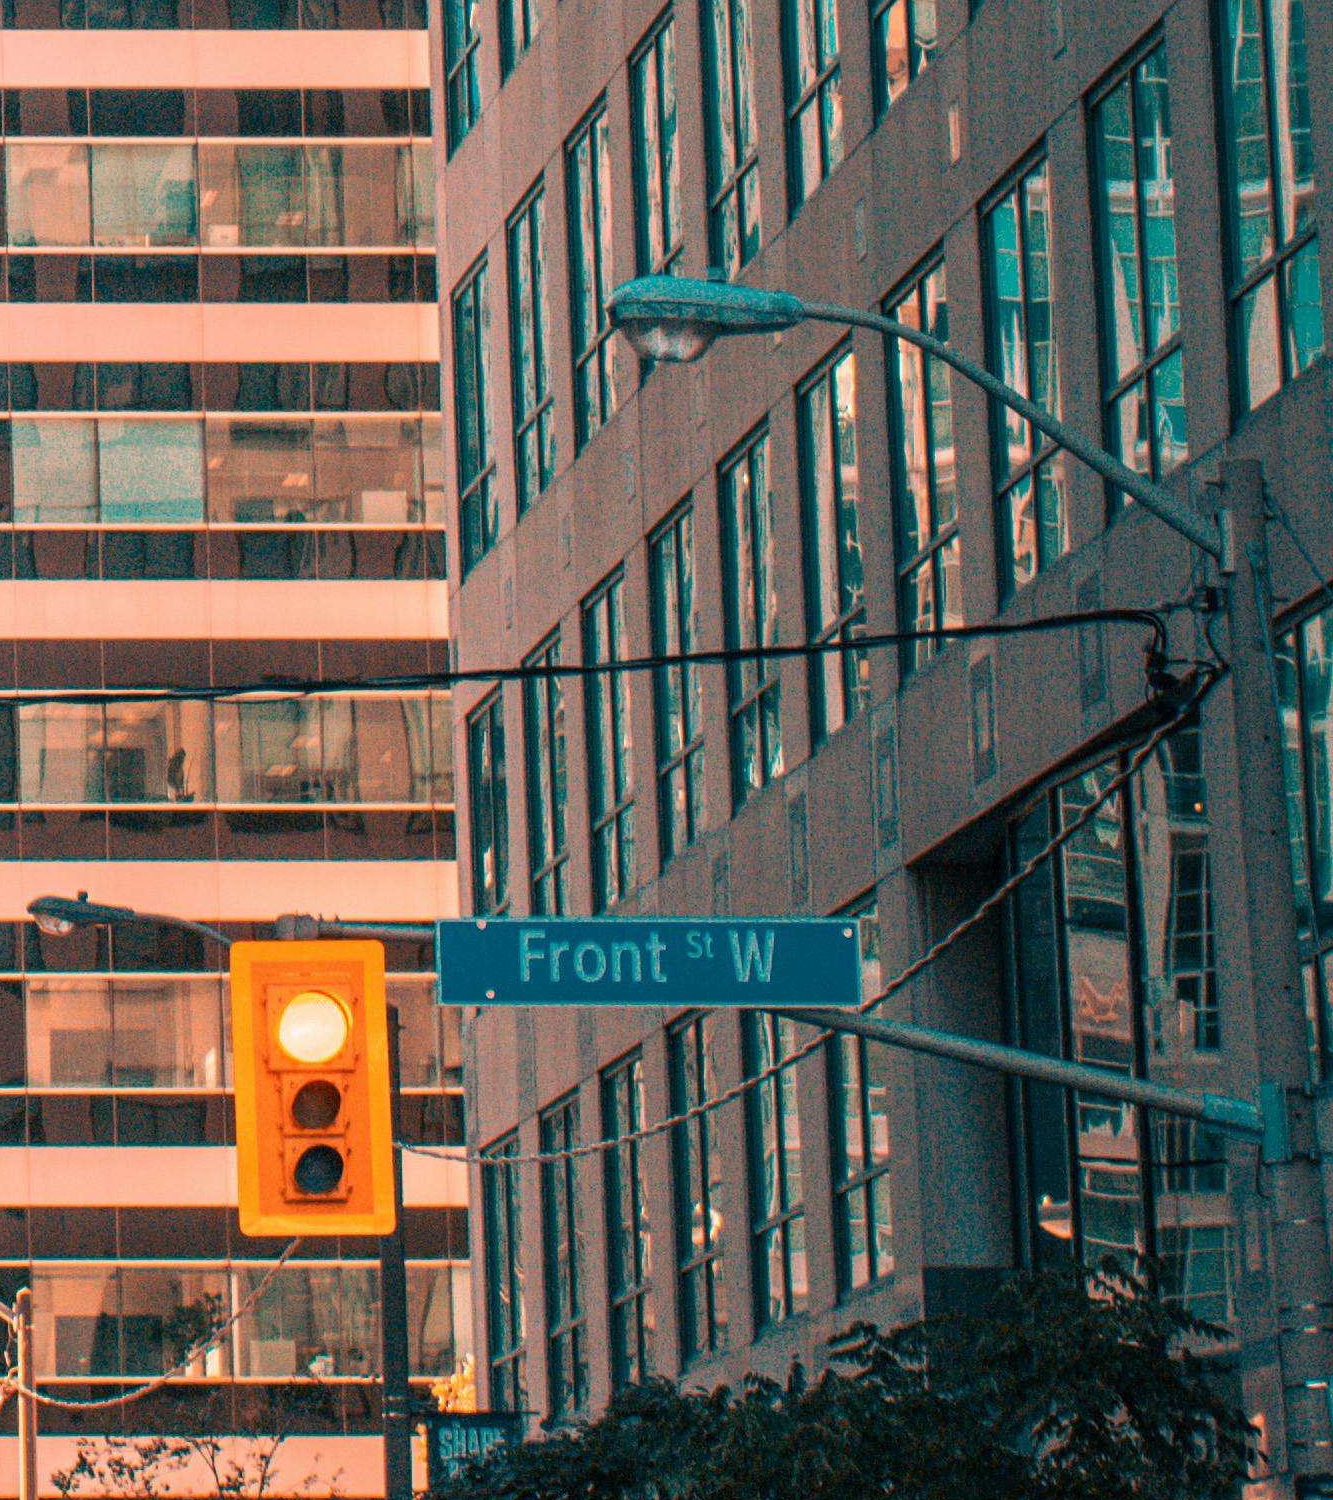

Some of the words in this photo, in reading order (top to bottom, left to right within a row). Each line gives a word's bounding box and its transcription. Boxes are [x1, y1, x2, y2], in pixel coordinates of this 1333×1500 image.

[518, 927, 667, 984] Front
[684, 929, 716, 959] St
[729, 928, 776, 984] W
